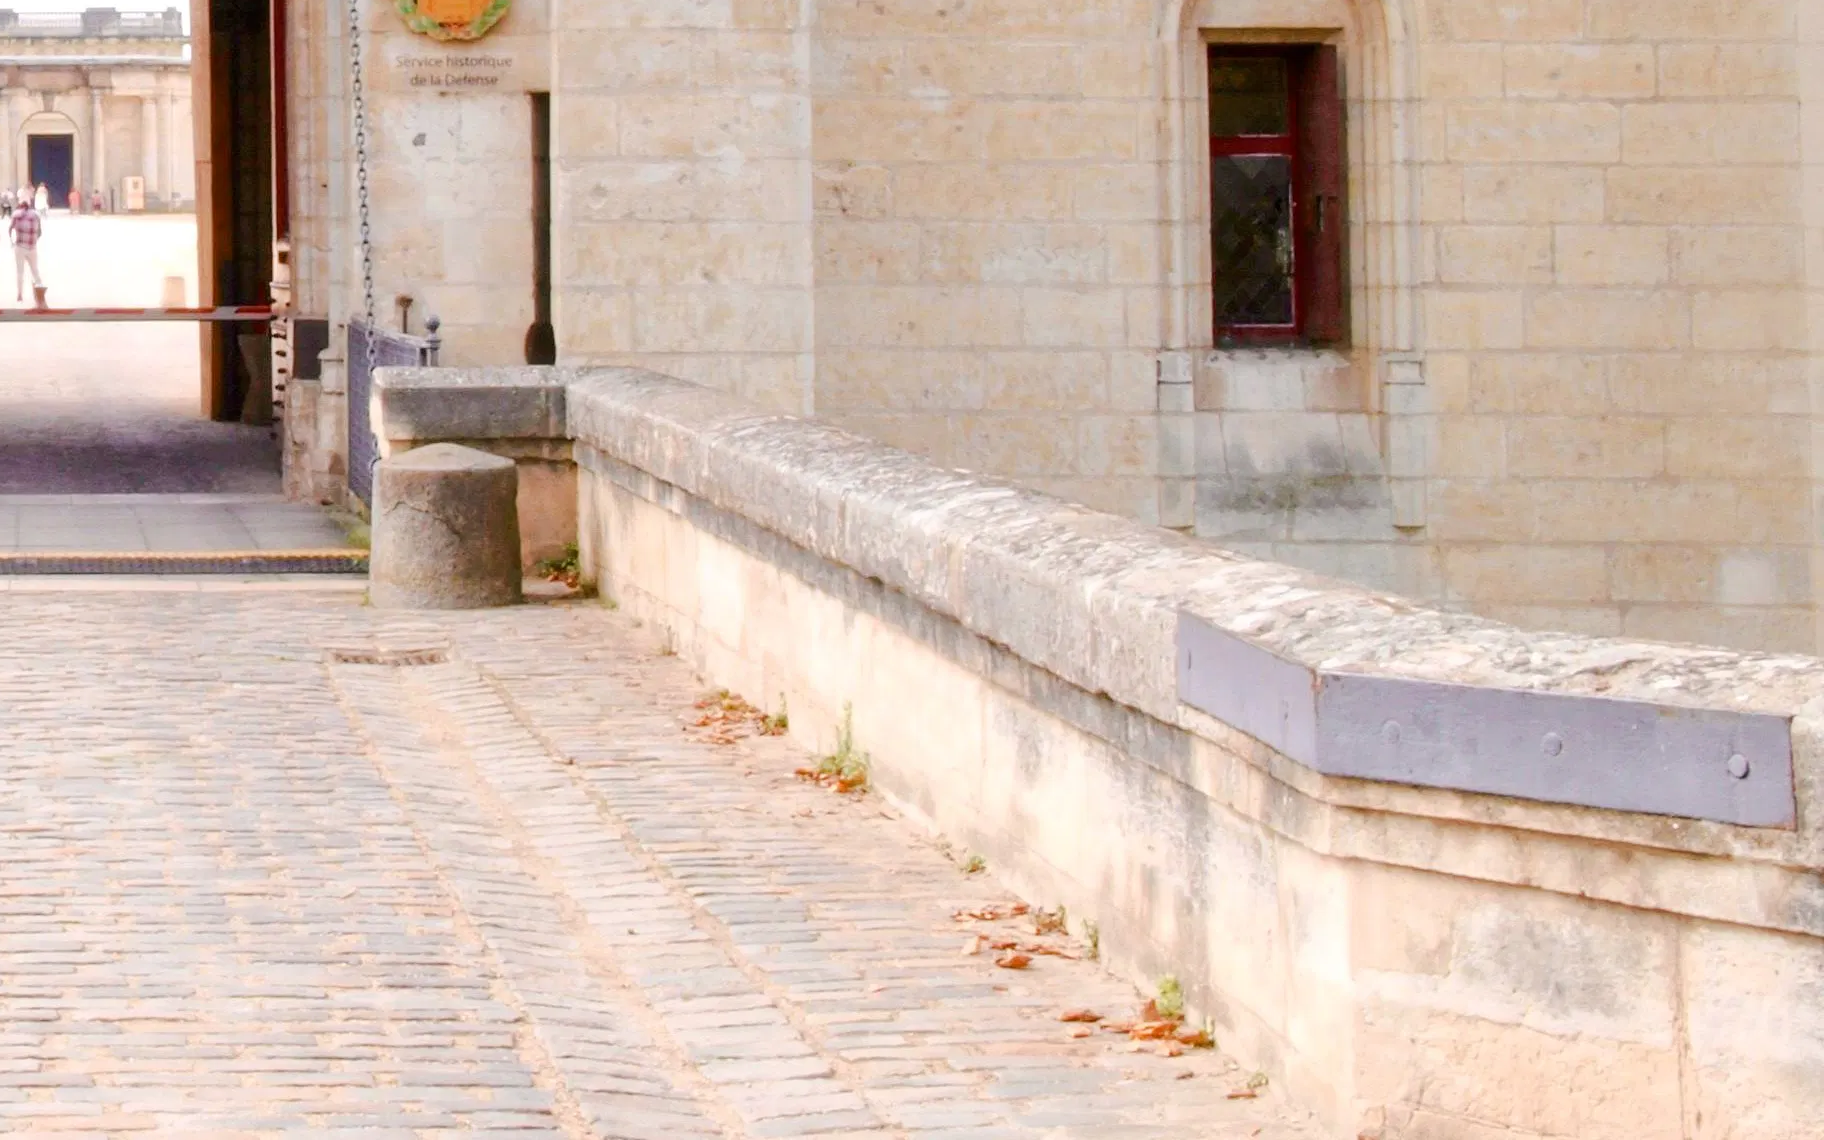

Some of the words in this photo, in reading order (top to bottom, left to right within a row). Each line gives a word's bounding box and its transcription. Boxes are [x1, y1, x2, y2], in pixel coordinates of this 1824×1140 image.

[395, 55, 442, 68] Service
[445, 55, 513, 69] historique
[409, 75, 427, 87] de
[429, 74, 441, 86] la
